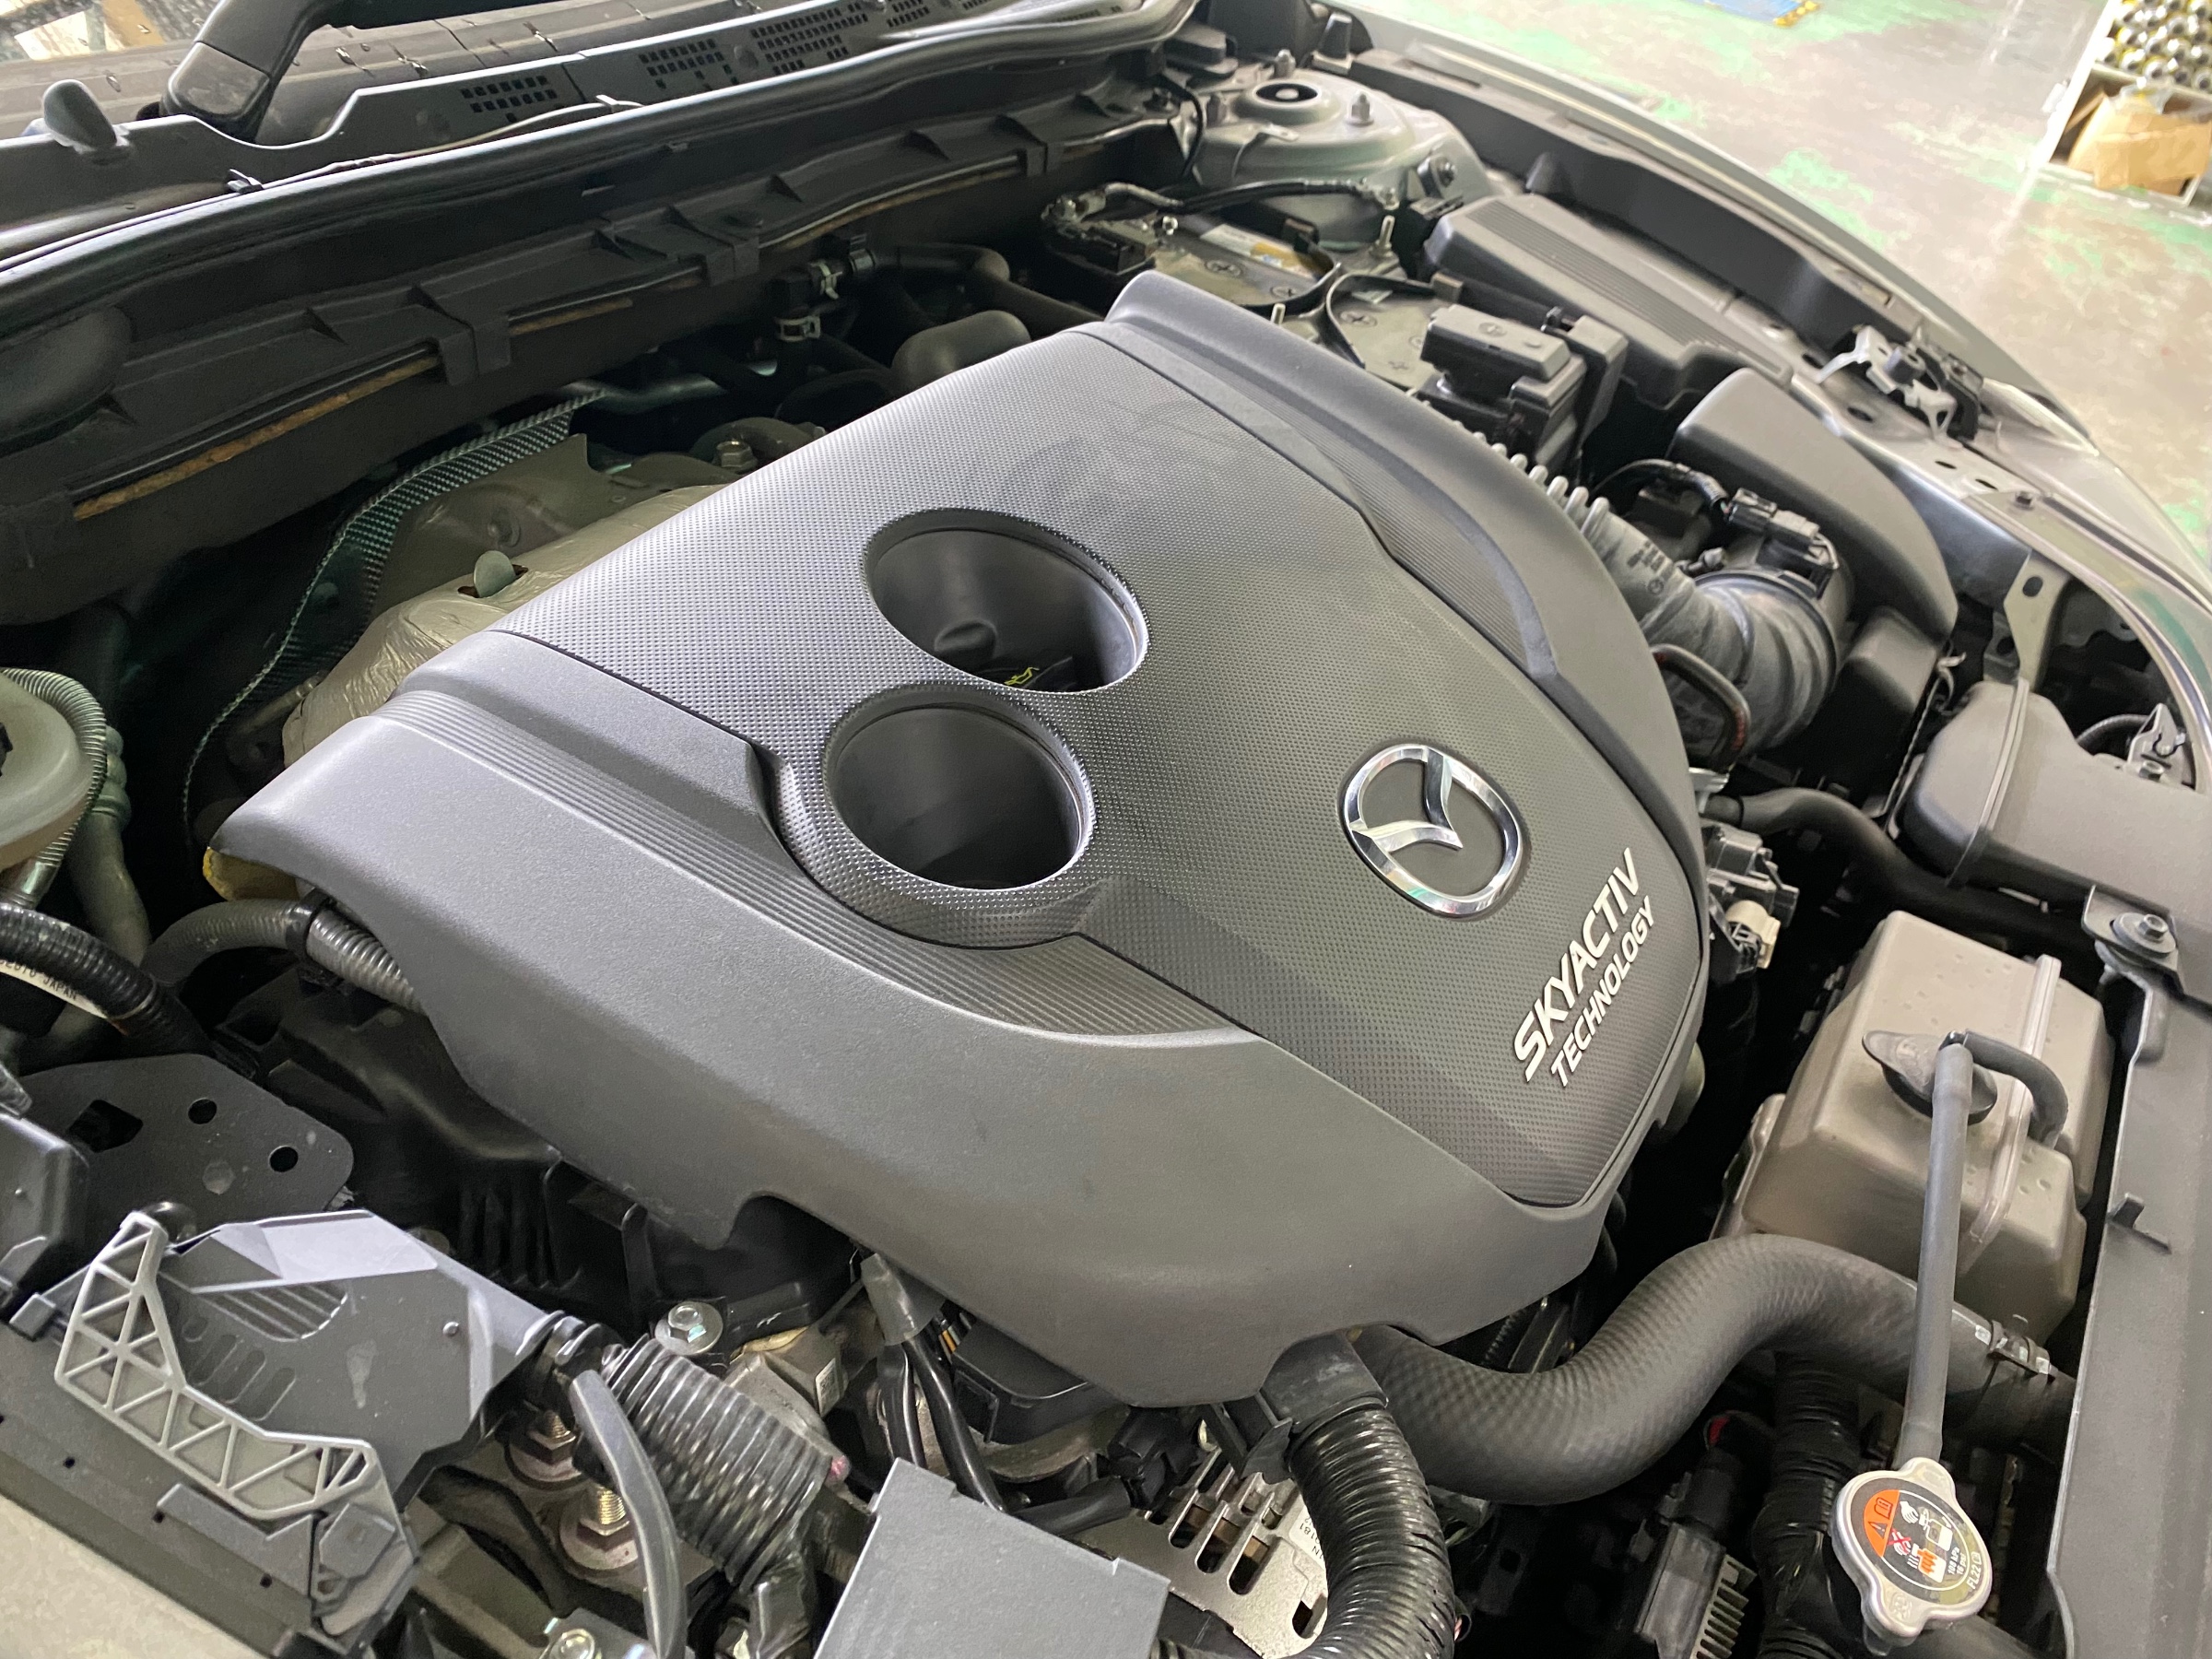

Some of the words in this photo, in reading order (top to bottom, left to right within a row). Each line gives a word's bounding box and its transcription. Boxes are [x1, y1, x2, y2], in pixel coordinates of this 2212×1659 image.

[42, 976, 77, 1001] JAPAN
[1513, 847, 1640, 1083] SKYACTIV
[1550, 895, 1654, 1087] TECHNOLOGY
[1966, 1564, 1982, 1589] FL22
